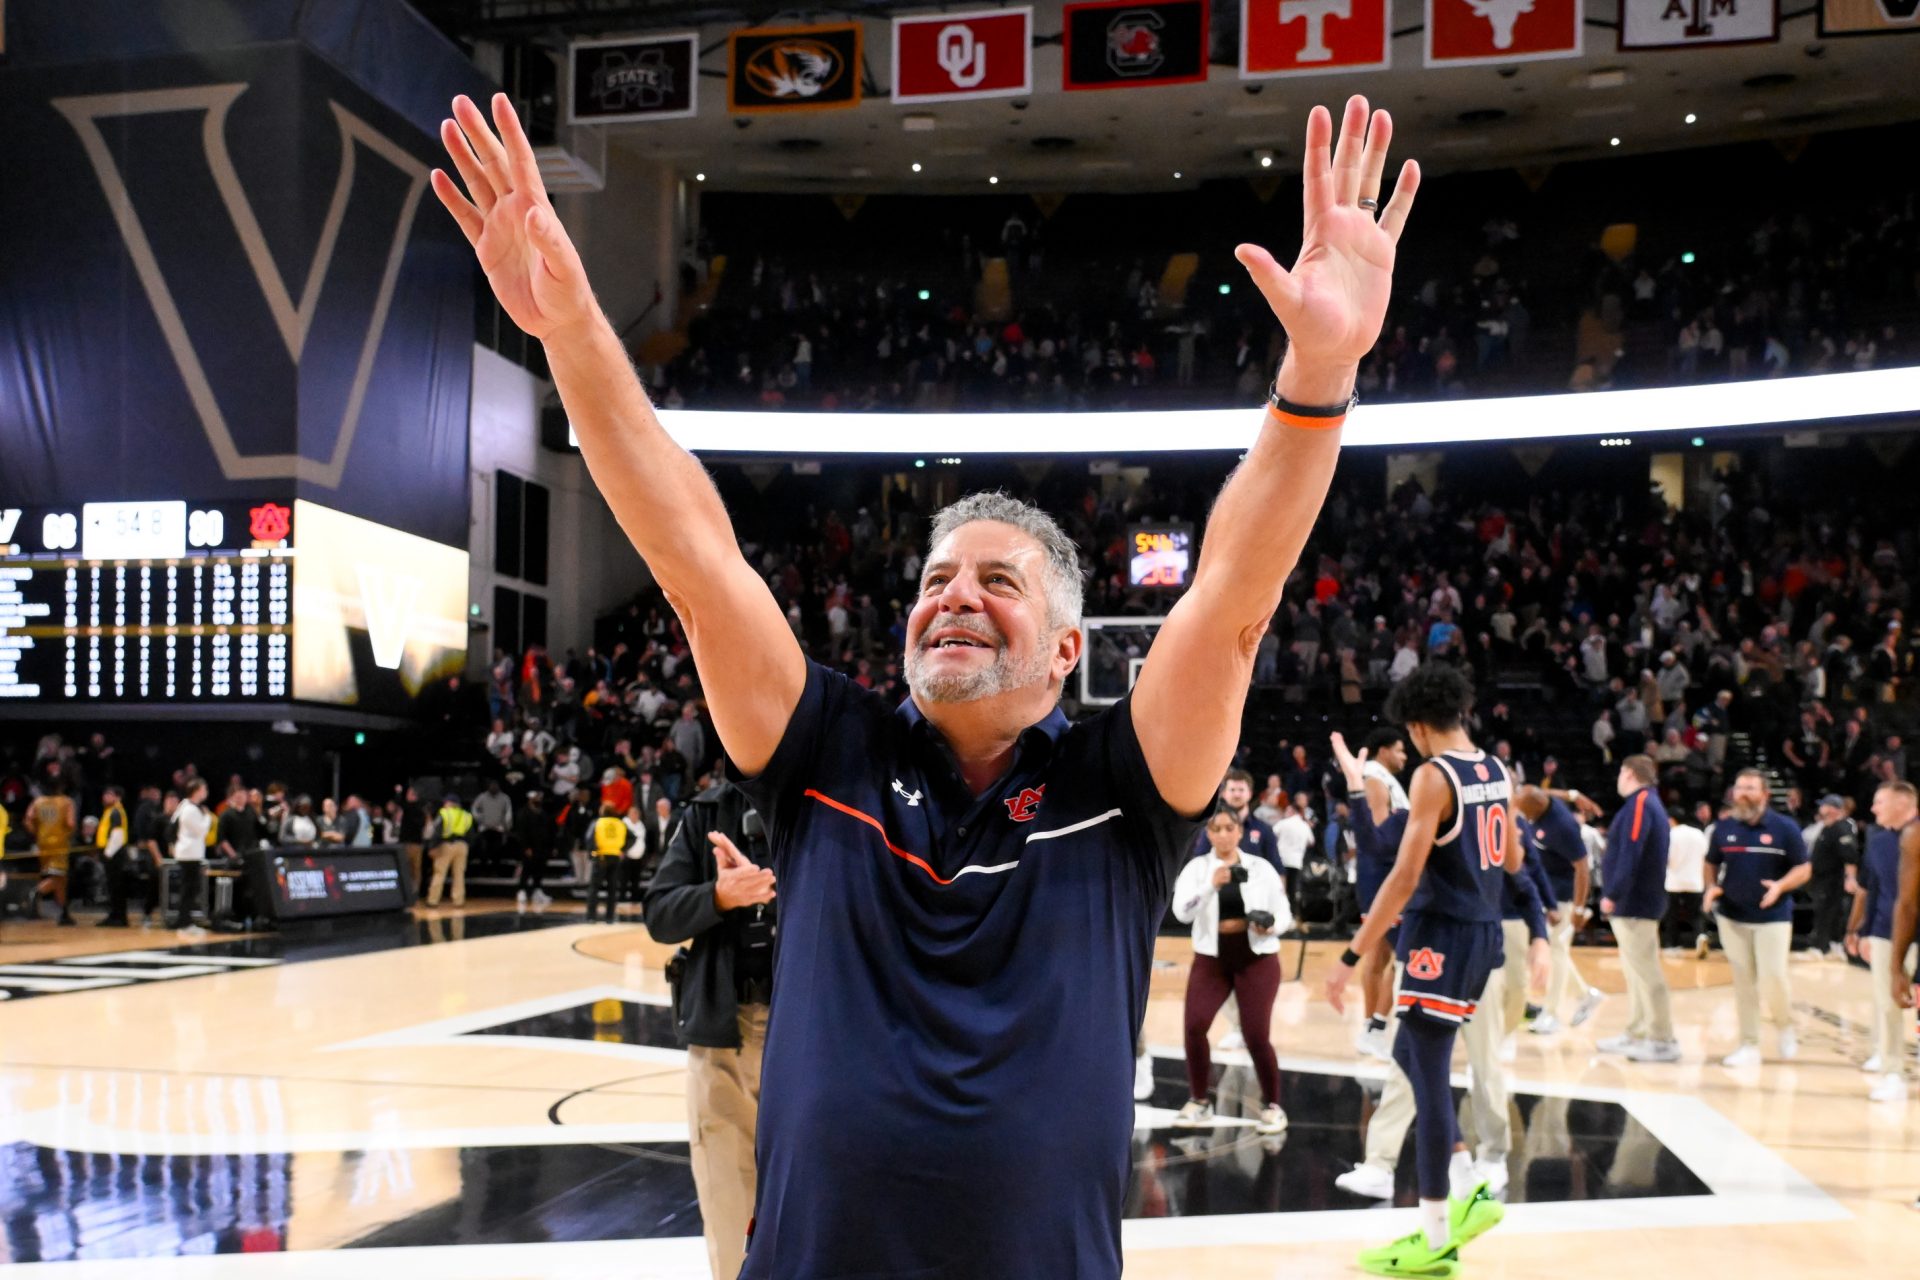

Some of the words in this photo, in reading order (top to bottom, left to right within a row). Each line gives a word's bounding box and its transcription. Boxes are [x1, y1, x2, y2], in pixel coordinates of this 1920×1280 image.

[937, 24, 986, 88] OU
[1279, 0, 1353, 62] T
[606, 68, 658, 88] STATE
[50, 82, 432, 488] V
[1476, 803, 1508, 871] 10
